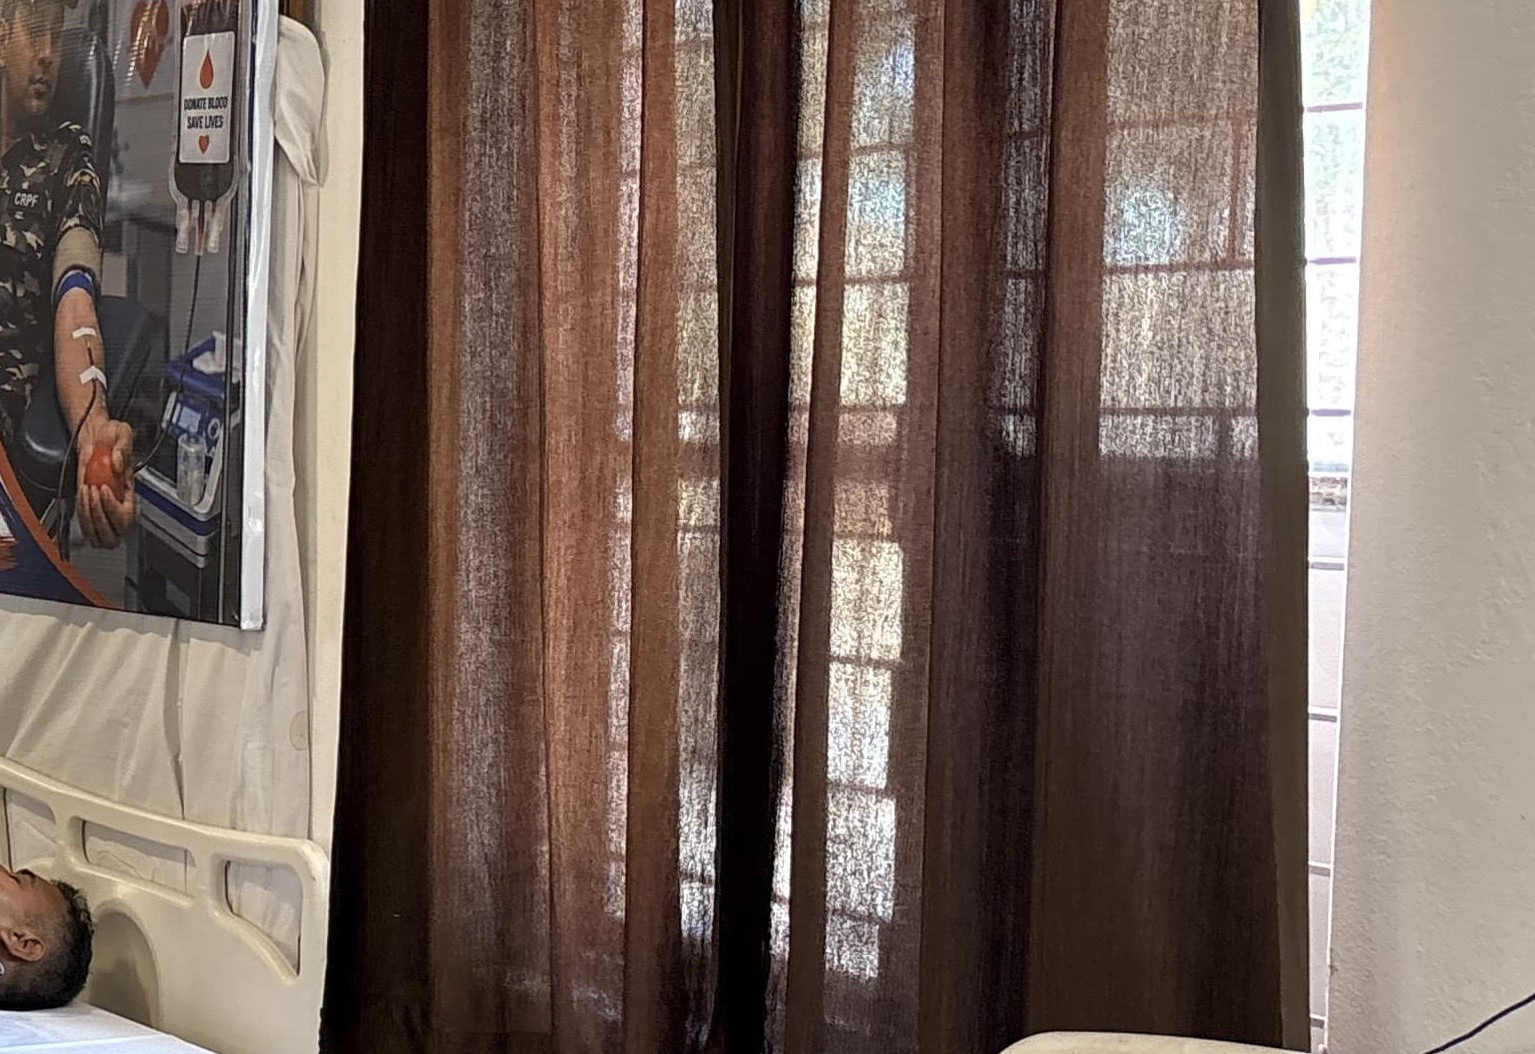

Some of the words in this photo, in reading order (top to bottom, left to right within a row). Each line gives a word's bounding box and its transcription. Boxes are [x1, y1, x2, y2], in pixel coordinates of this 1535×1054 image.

[187, 115, 204, 129] SAVE
[205, 115, 224, 129] LIVES
[15, 192, 39, 208] CRPF
